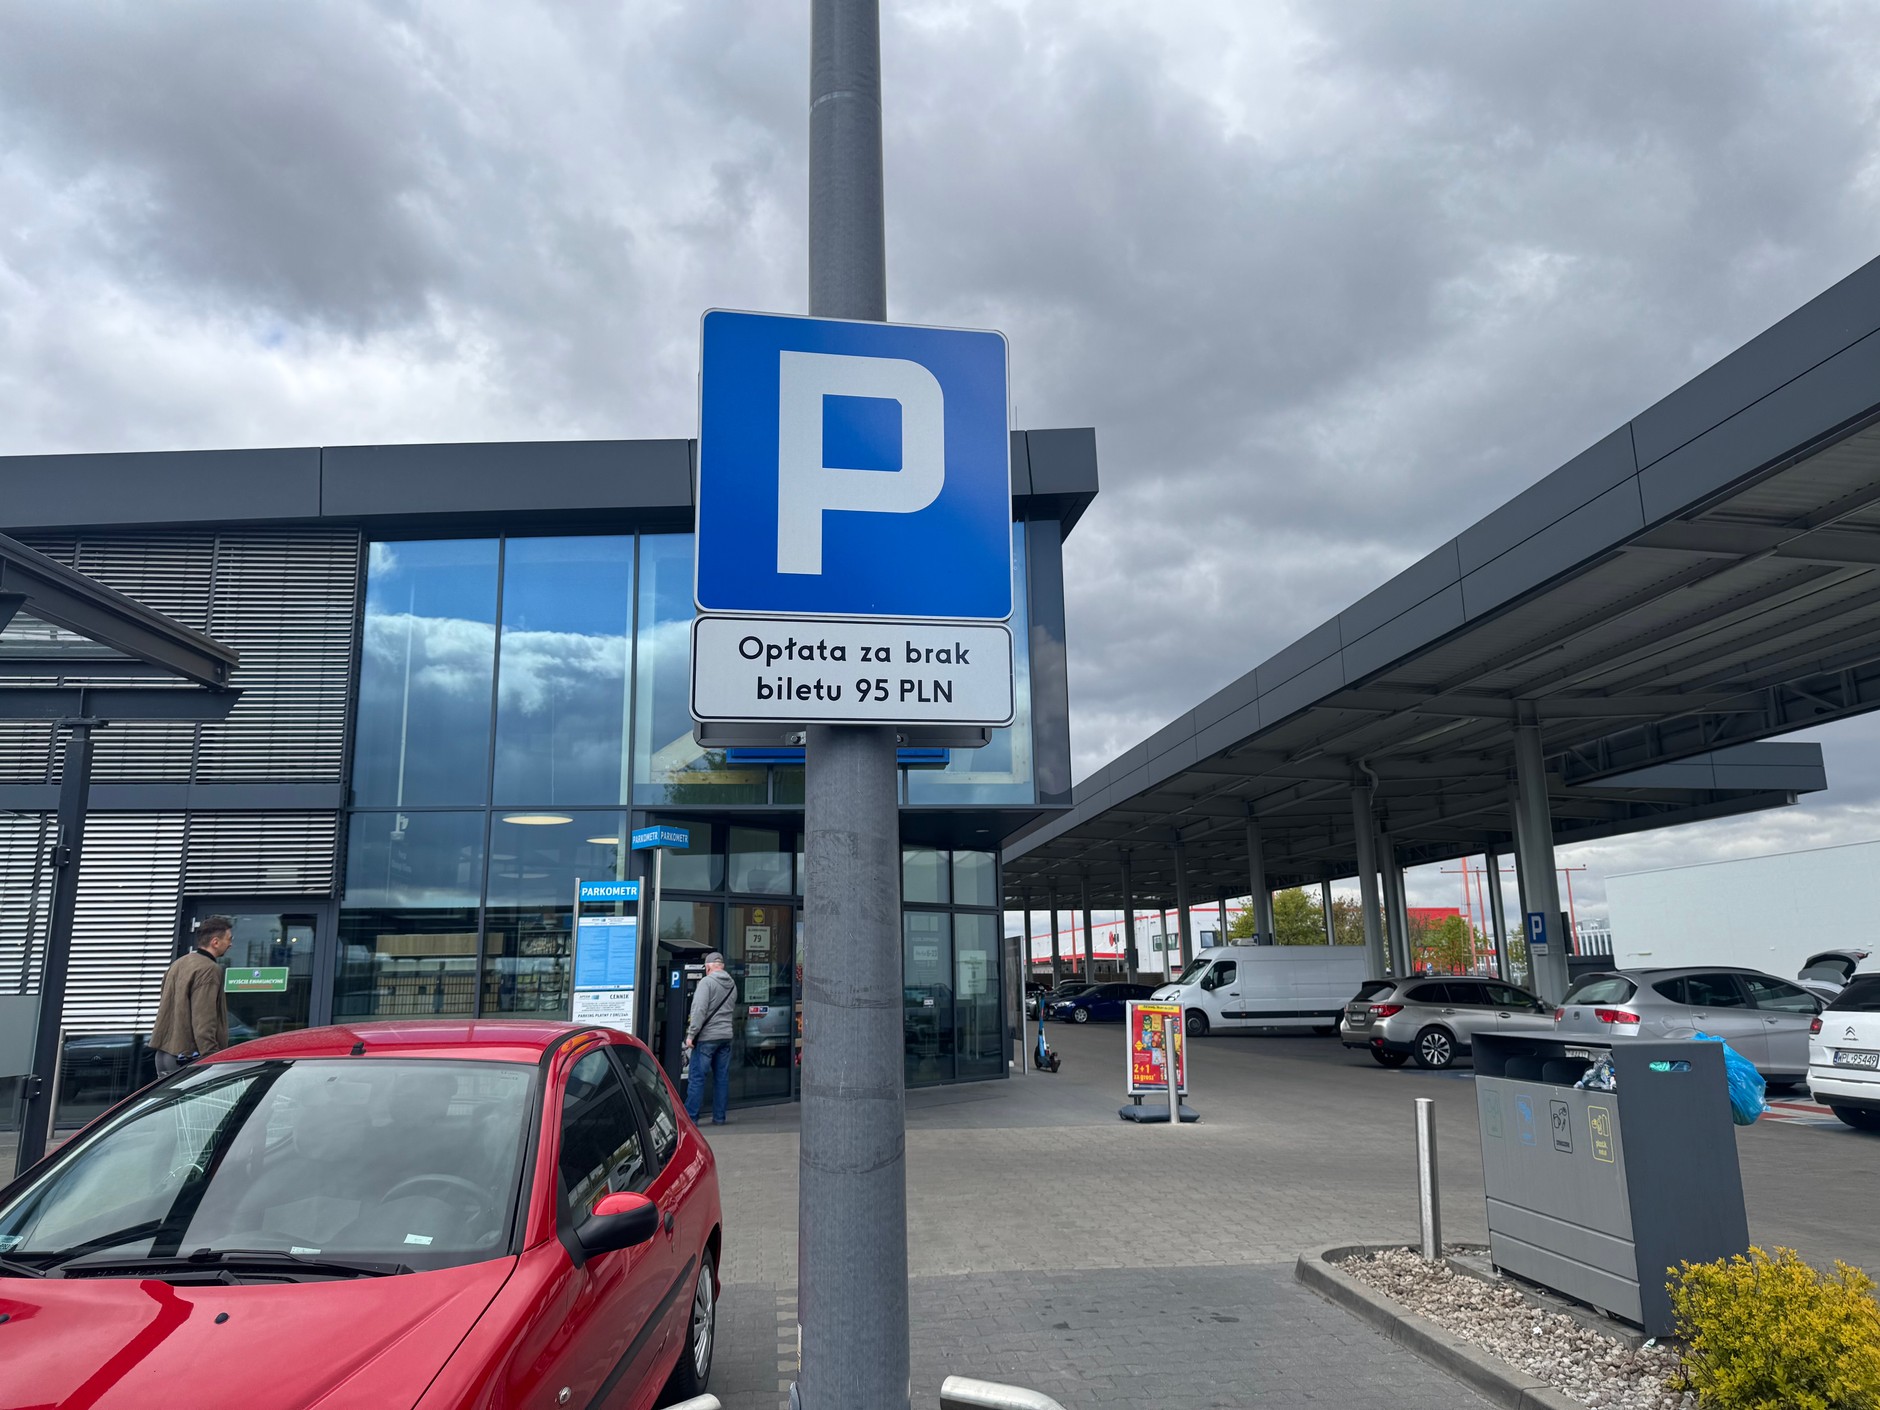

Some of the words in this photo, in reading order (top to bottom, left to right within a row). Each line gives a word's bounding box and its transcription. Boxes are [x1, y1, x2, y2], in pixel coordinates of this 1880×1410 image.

[777, 350, 945, 575] P
[739, 636, 847, 667] Opłata
[860, 646, 891, 662] za
[906, 641, 970, 665] brak
[757, 676, 842, 701] biletu
[855, 678, 889, 703] 95
[900, 679, 953, 703] PLN
[632, 831, 658, 844] PARKOMETR
[660, 831, 689, 844] PARKOMETR
[581, 886, 637, 896] PARKOMETR
[1531, 915, 1543, 940] P
[753, 934, 762, 943] 79
[671, 971, 680, 986] P
[1852, 1054, 1877, 1066] 95449
